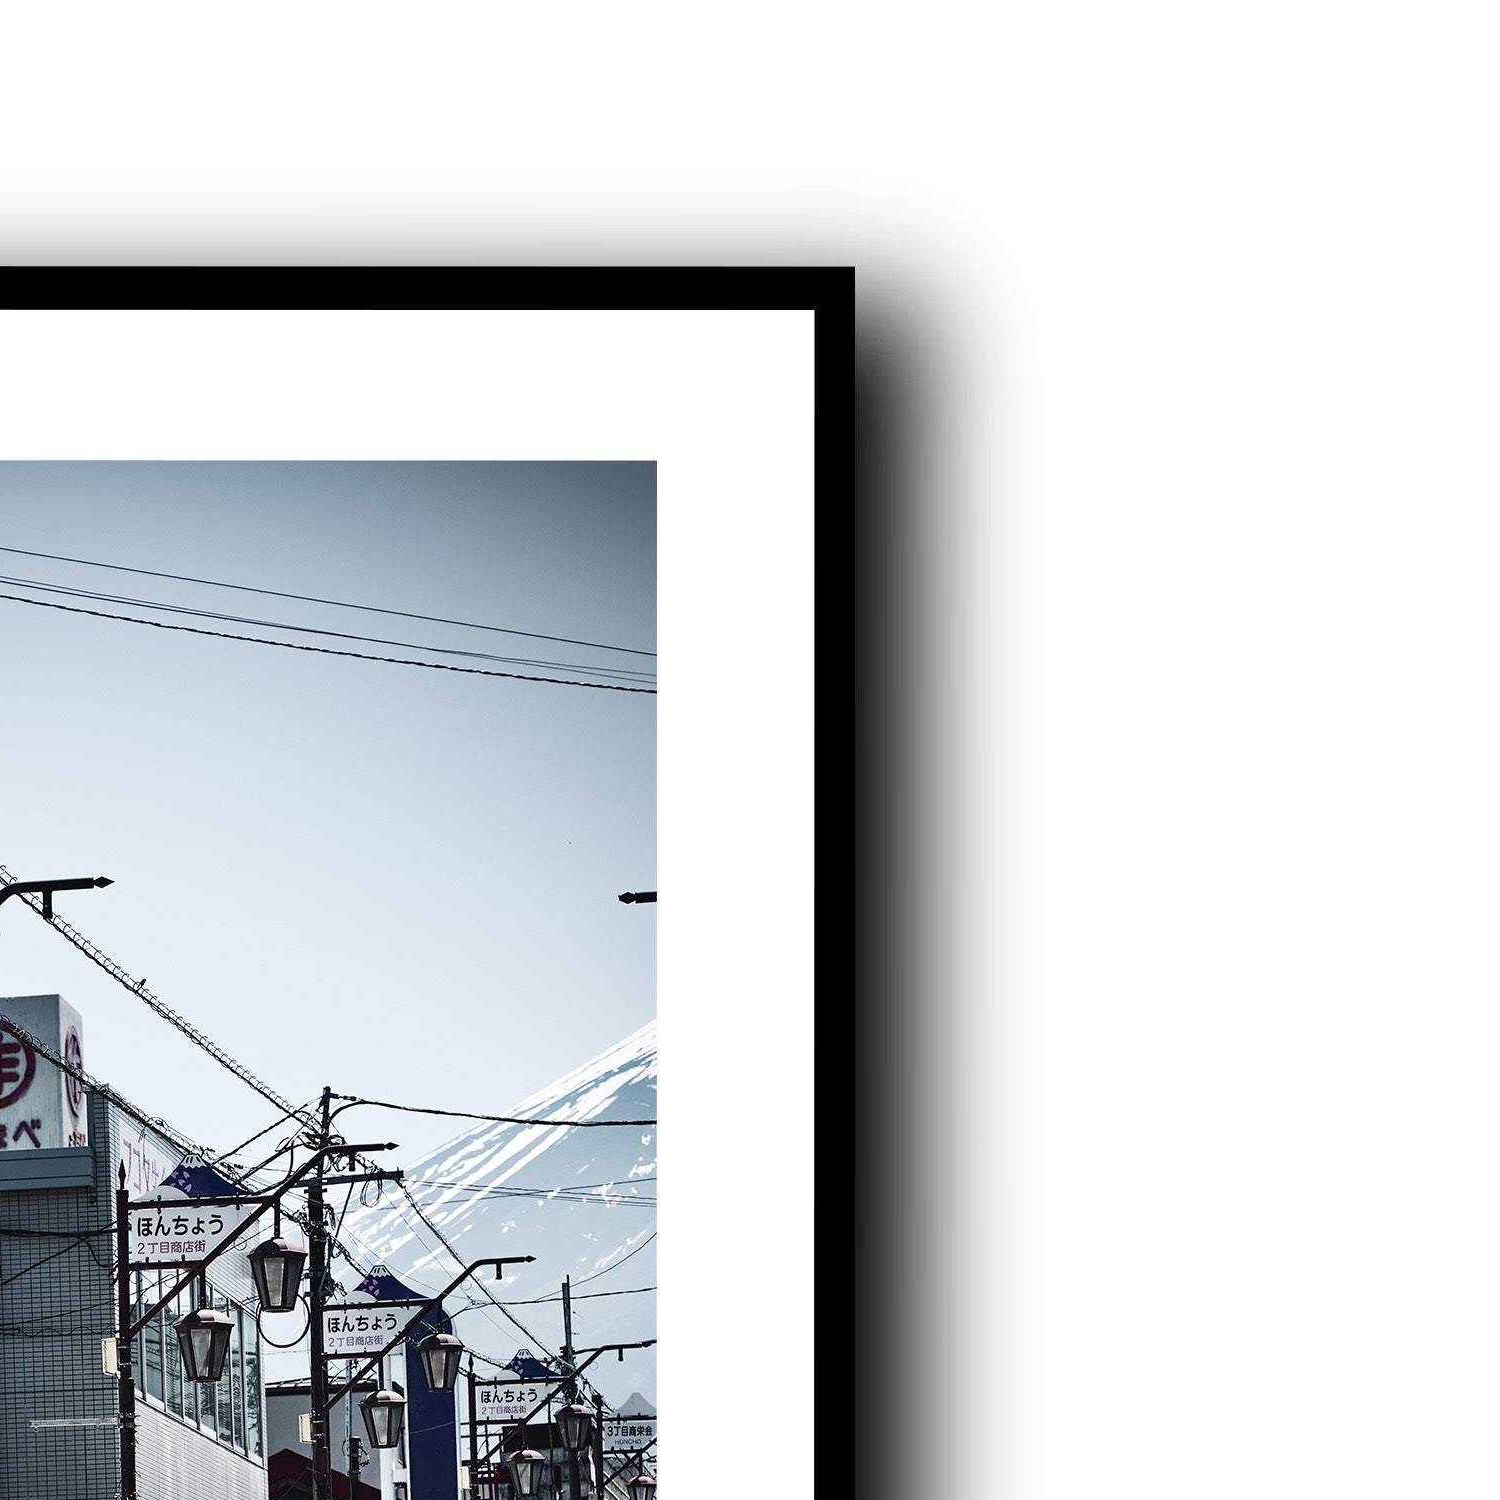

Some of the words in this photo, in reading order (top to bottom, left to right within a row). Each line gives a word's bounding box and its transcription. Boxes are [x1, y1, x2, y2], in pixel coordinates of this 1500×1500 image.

[137, 1214, 224, 1237] ほんちょう
[137, 1240, 206, 1255] 2丁目商店街
[327, 1313, 397, 1333] ほんちょう
[328, 1335, 383, 1347] 2丁目商店街
[481, 1388, 538, 1404] ほんちょう
